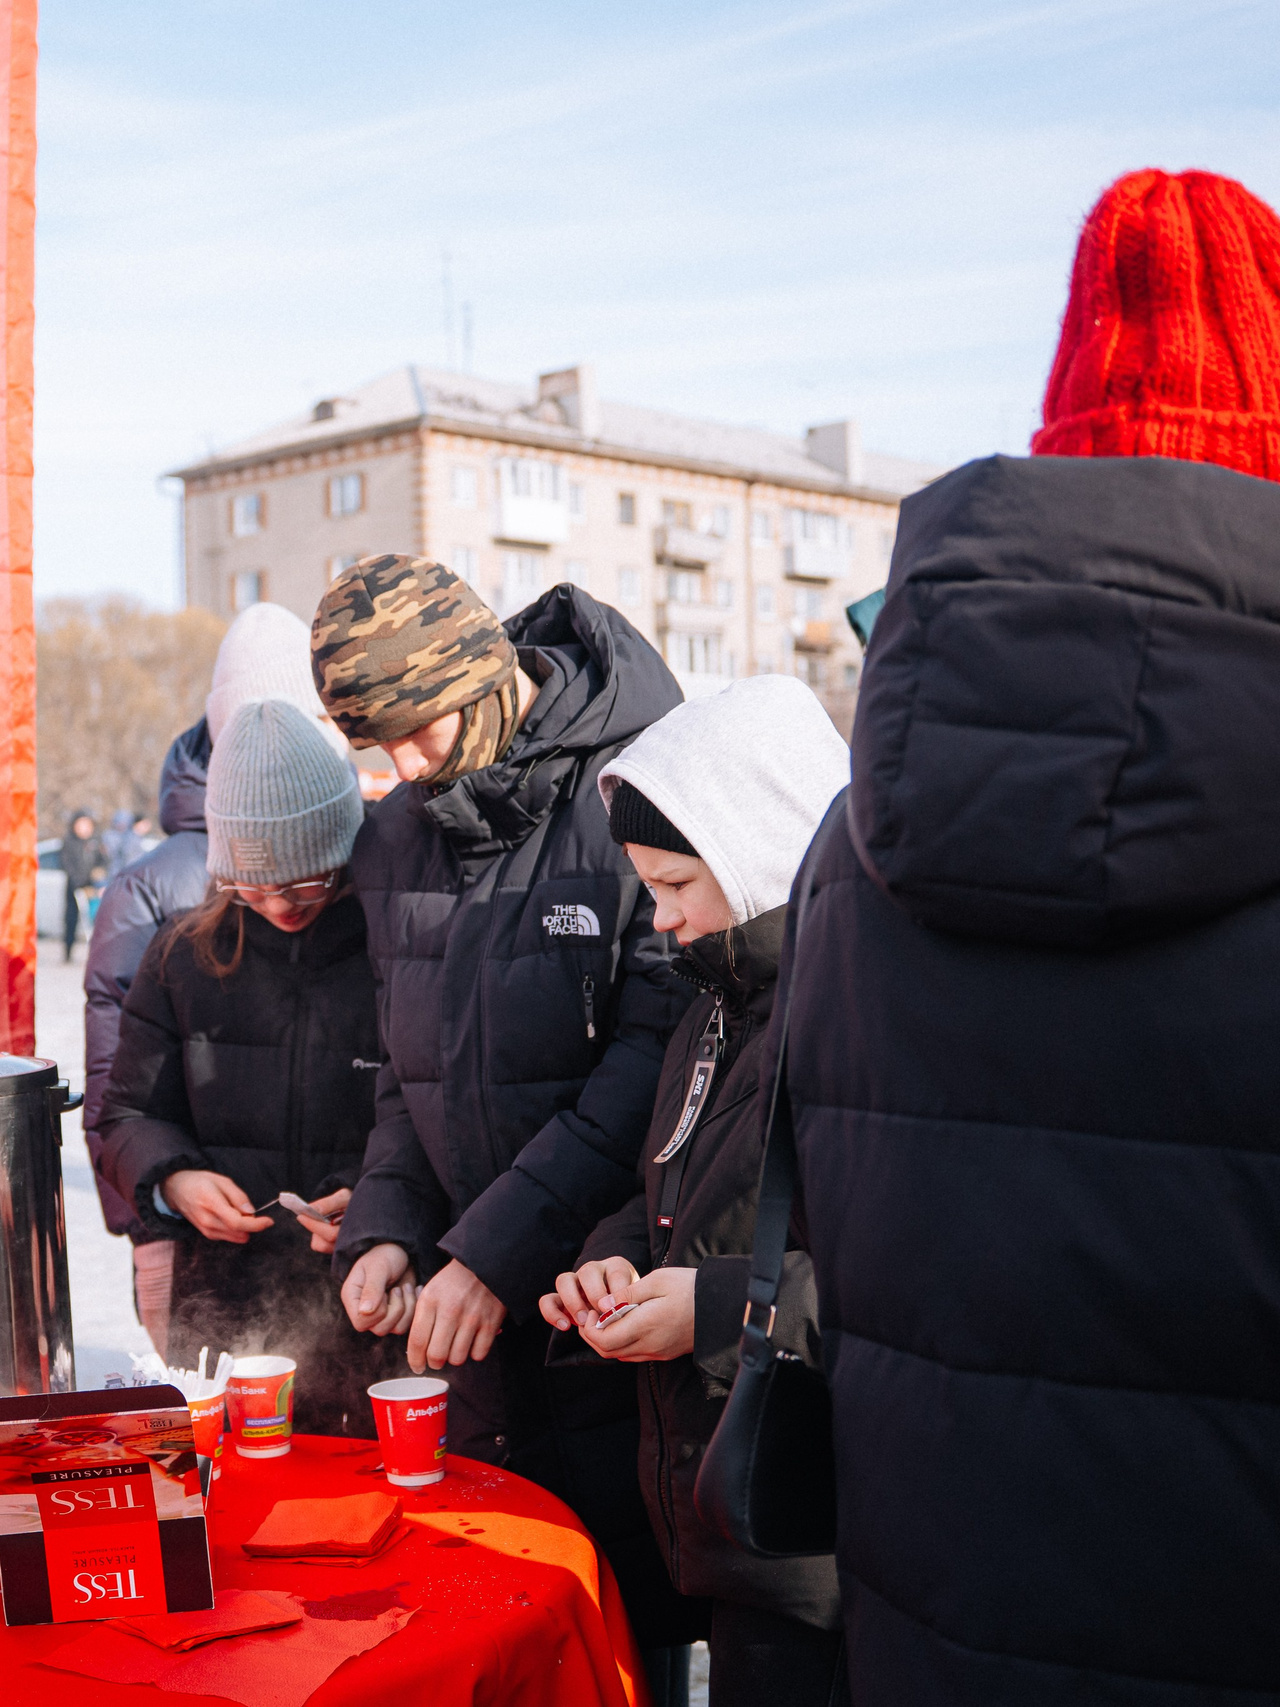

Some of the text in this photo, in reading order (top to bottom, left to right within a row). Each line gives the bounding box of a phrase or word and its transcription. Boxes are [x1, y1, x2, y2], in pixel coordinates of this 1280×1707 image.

[552, 904, 577, 915] THE
[549, 925, 578, 936] FACE
[241, 1386, 267, 1395] Банк
[191, 1406, 219, 1422] Альфа
[406, 1405, 439, 1421] Альфа
[50, 1466, 133, 1481] PLEASURE
[51, 1484, 145, 1515] TESS
[73, 1554, 136, 1568] PLEASURE
[73, 1569, 145, 1604] TESS
